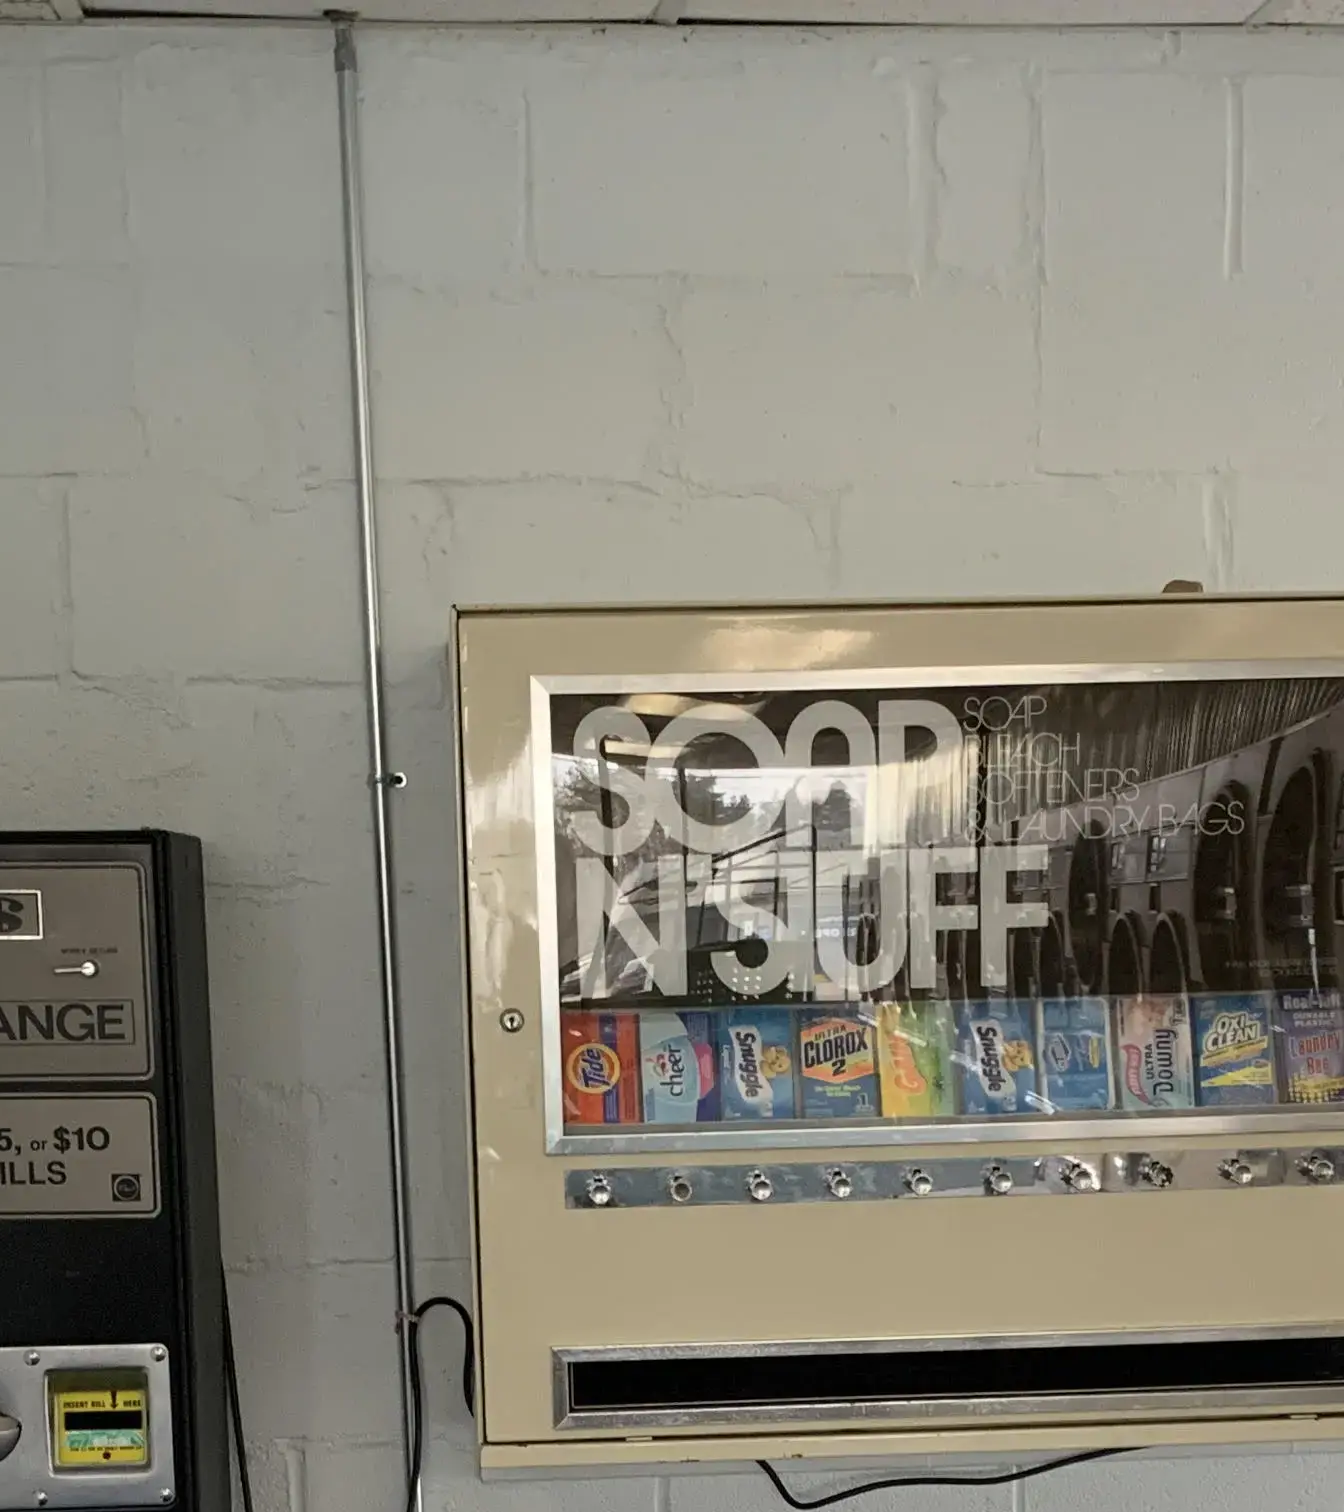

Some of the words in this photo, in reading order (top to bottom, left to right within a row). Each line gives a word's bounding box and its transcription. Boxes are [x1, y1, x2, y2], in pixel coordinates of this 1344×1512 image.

[962, 695, 1048, 732] SOAP
[964, 731, 1081, 769] BLEACH
[572, 699, 963, 856] SOAP
[966, 767, 1141, 806] SOFTENERS
[963, 808, 992, 843] &
[1003, 805, 1151, 842] LAUNDRY
[1158, 801, 1246, 837] BAGS
[814, 1023, 847, 1042] ULTRA
[1206, 1025, 1257, 1052] CLEAN
[1217, 1017, 1245, 1034] OXI
[734, 1031, 764, 1098] Snuggle
[803, 1026, 869, 1069] CLOROX
[976, 1026, 1007, 1092] Snuggle
[1145, 1043, 1153, 1081] ULTRA
[1153, 1028, 1177, 1096] Downy
[581, 1047, 611, 1089] Tide
[659, 1043, 685, 1097] cheer
[831, 1058, 847, 1077] 2
[29, 1136, 47, 1151] or
[52, 1125, 111, 1155] $10
